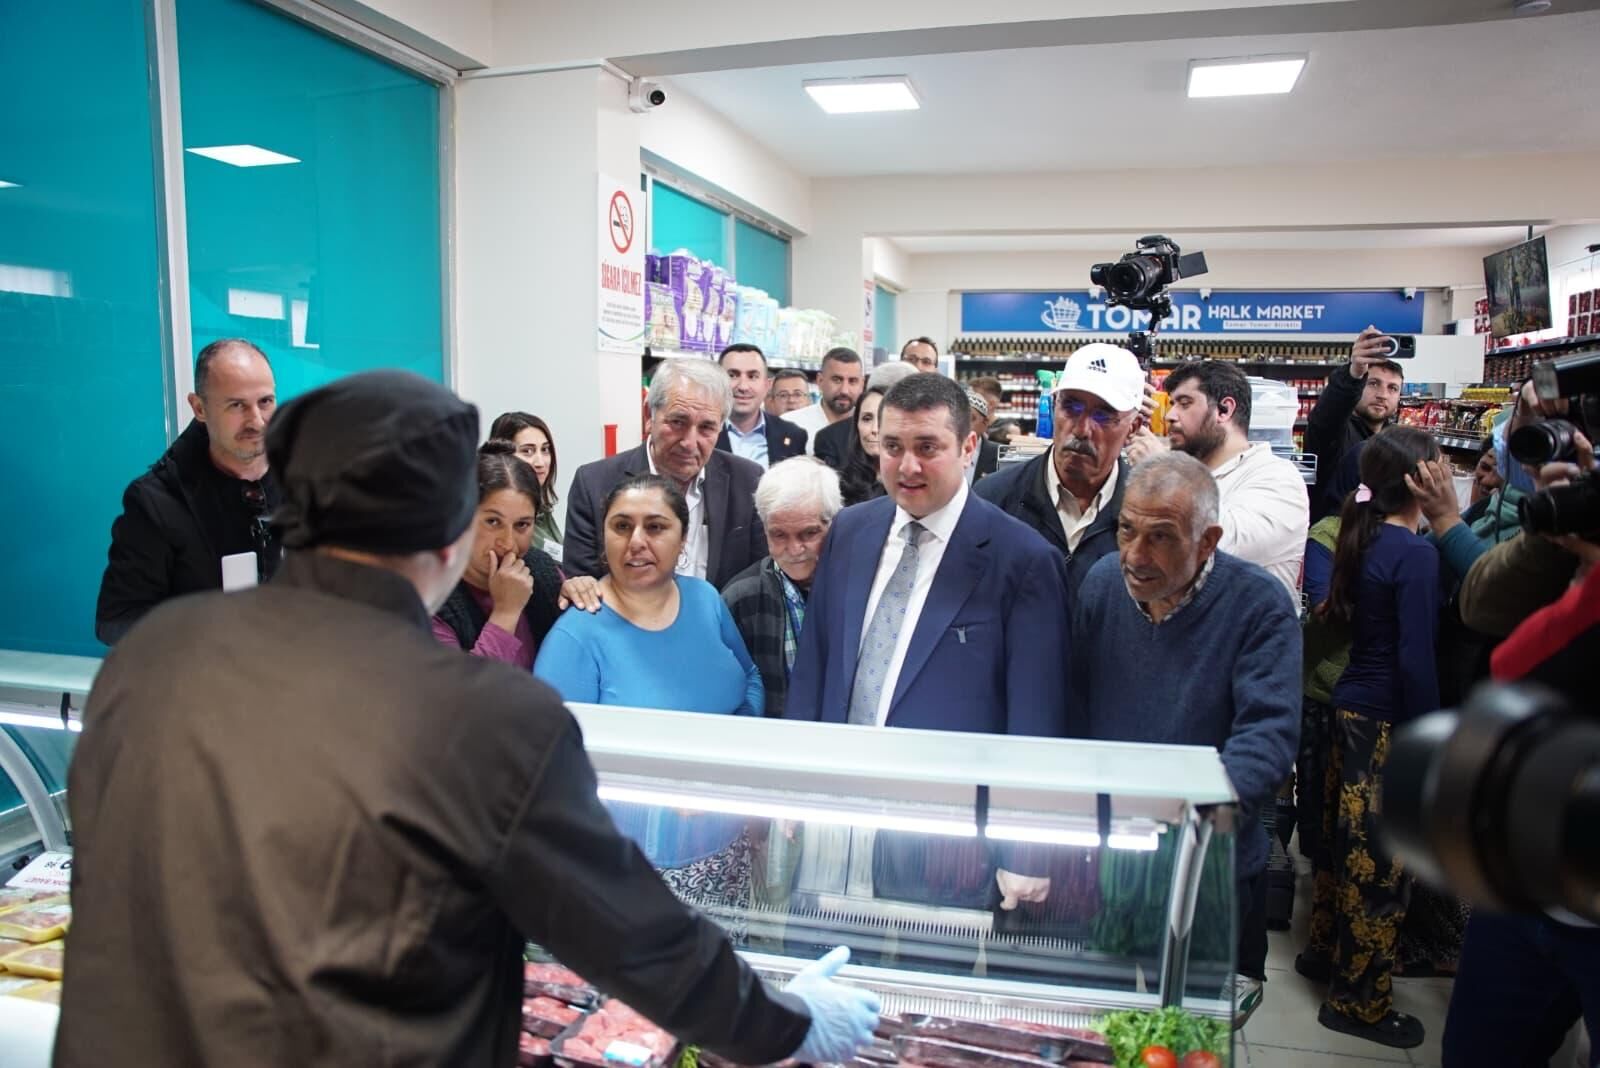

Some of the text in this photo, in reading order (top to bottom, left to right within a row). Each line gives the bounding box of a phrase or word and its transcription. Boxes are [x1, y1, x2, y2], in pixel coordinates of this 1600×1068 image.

[1086, 303, 1326, 331] TOMAR HALK MARKET
